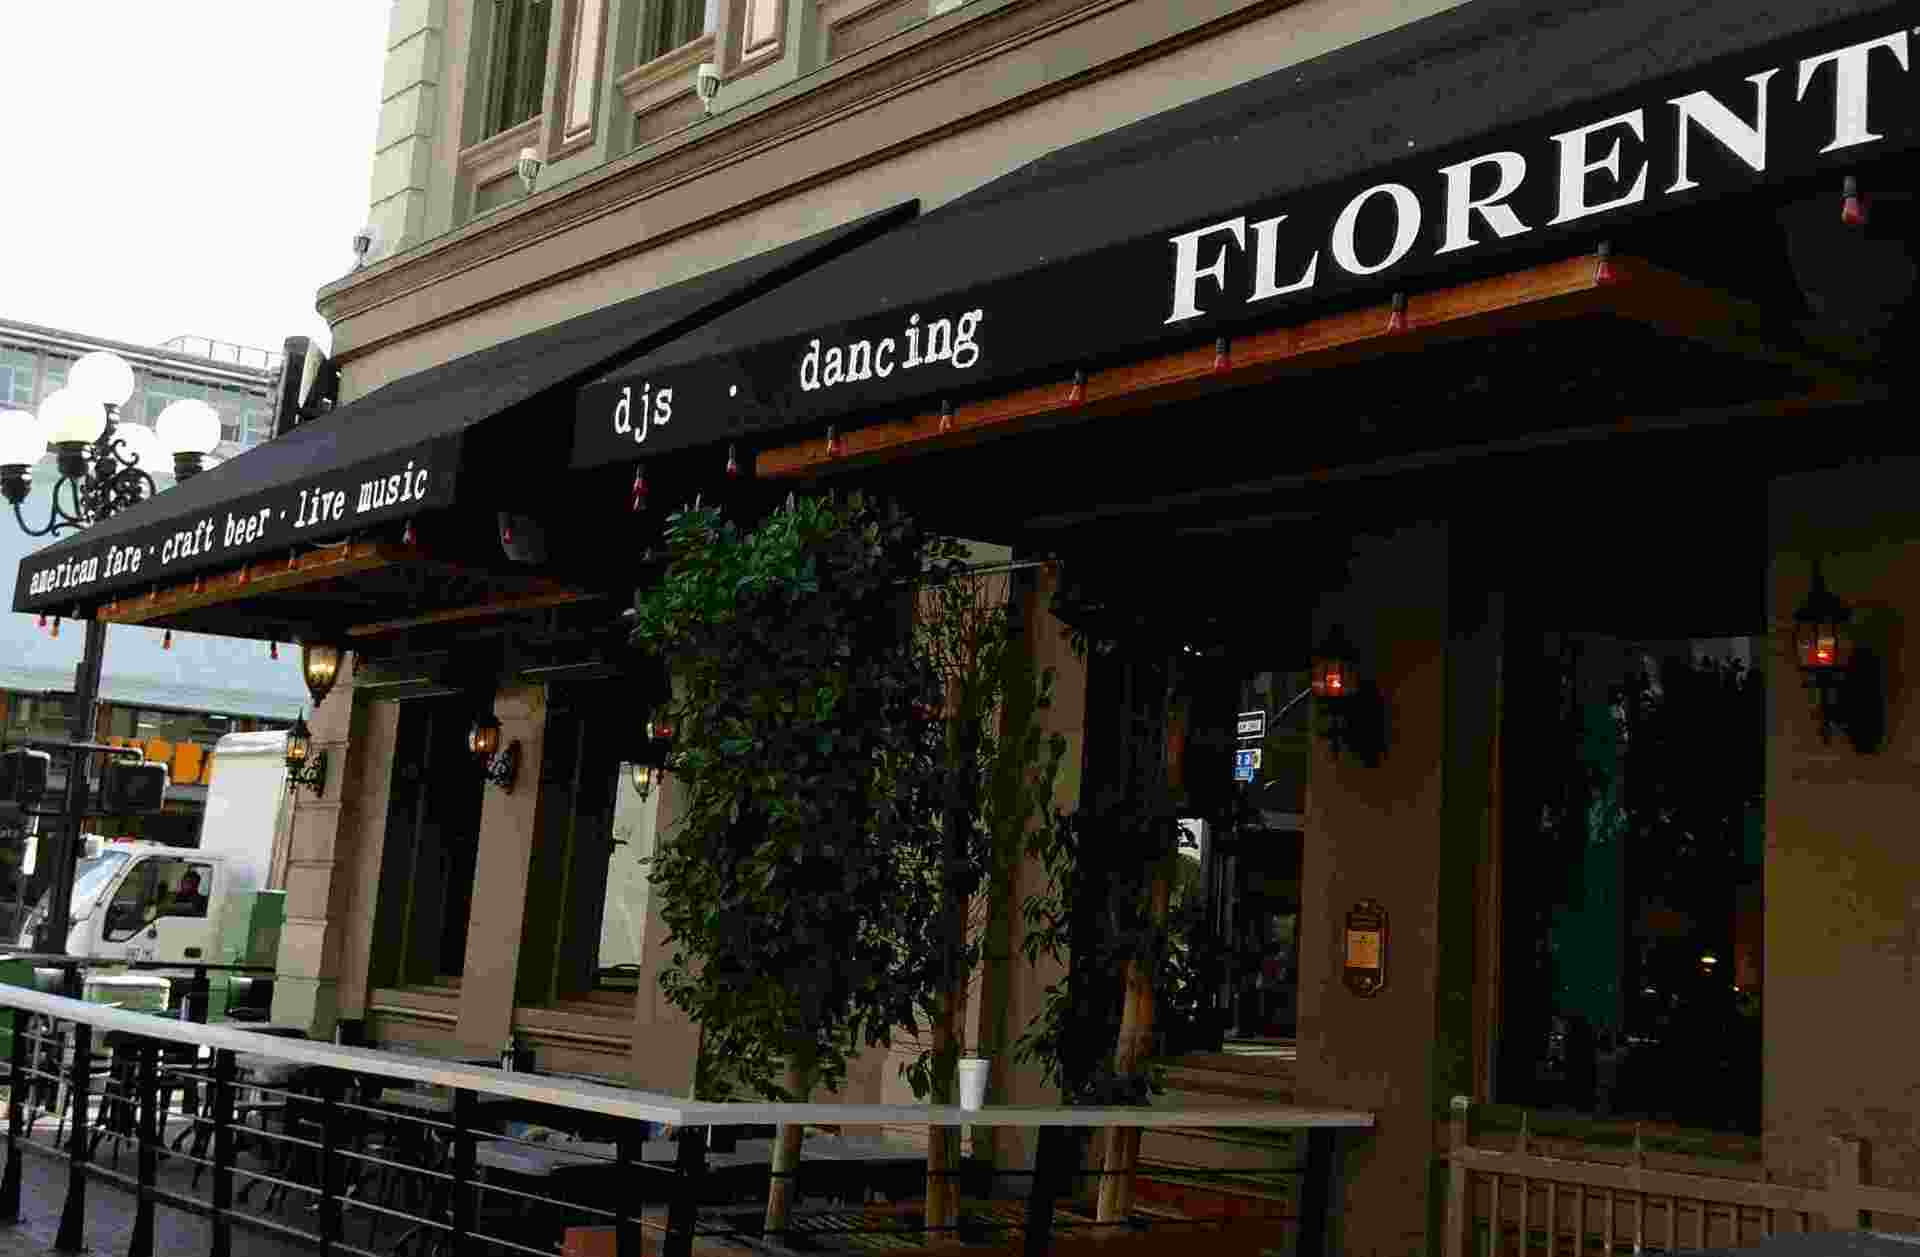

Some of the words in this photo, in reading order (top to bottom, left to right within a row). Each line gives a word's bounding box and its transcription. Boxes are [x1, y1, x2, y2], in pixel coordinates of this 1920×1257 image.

[1163, 26, 1920, 325] FLORENT
[614, 382, 673, 444] djs
[800, 308, 984, 392] dancing
[29, 556, 99, 596] american
[102, 545, 142, 579] fare
[161, 519, 215, 565] craft
[223, 507, 271, 547] beer
[293, 487, 346, 529] live
[356, 460, 428, 514] music
